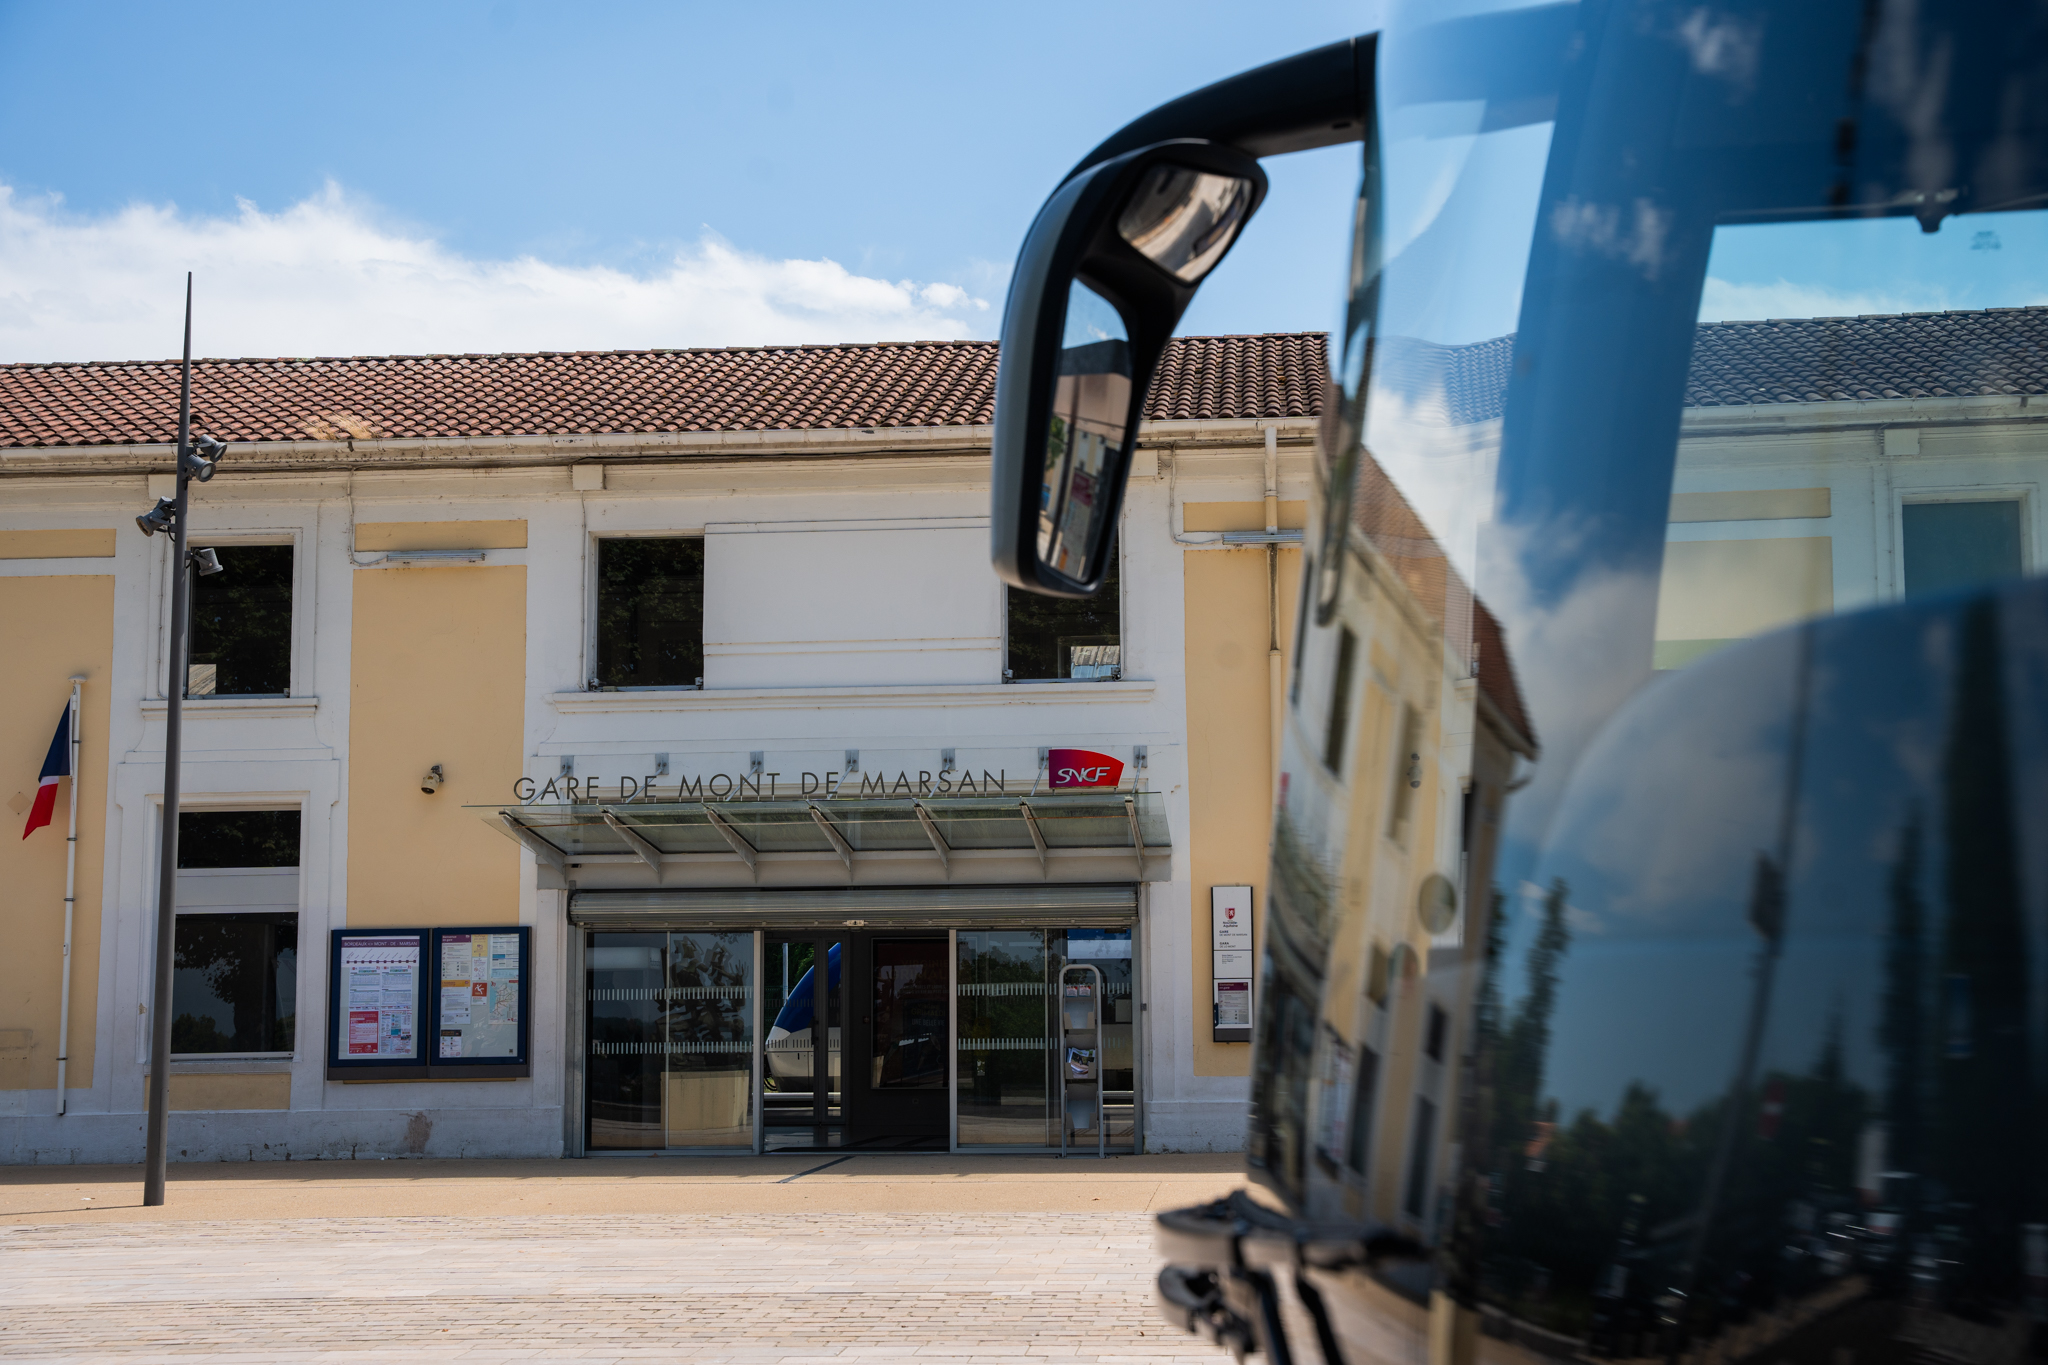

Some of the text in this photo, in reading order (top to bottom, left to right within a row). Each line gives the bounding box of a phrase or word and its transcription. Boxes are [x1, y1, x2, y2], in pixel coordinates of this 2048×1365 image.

[1055, 766, 1111, 784] SNCF
[513, 768, 1005, 801] GARE DE MONT DE MARSAN
[889, 968, 948, 980] GRIMAL
